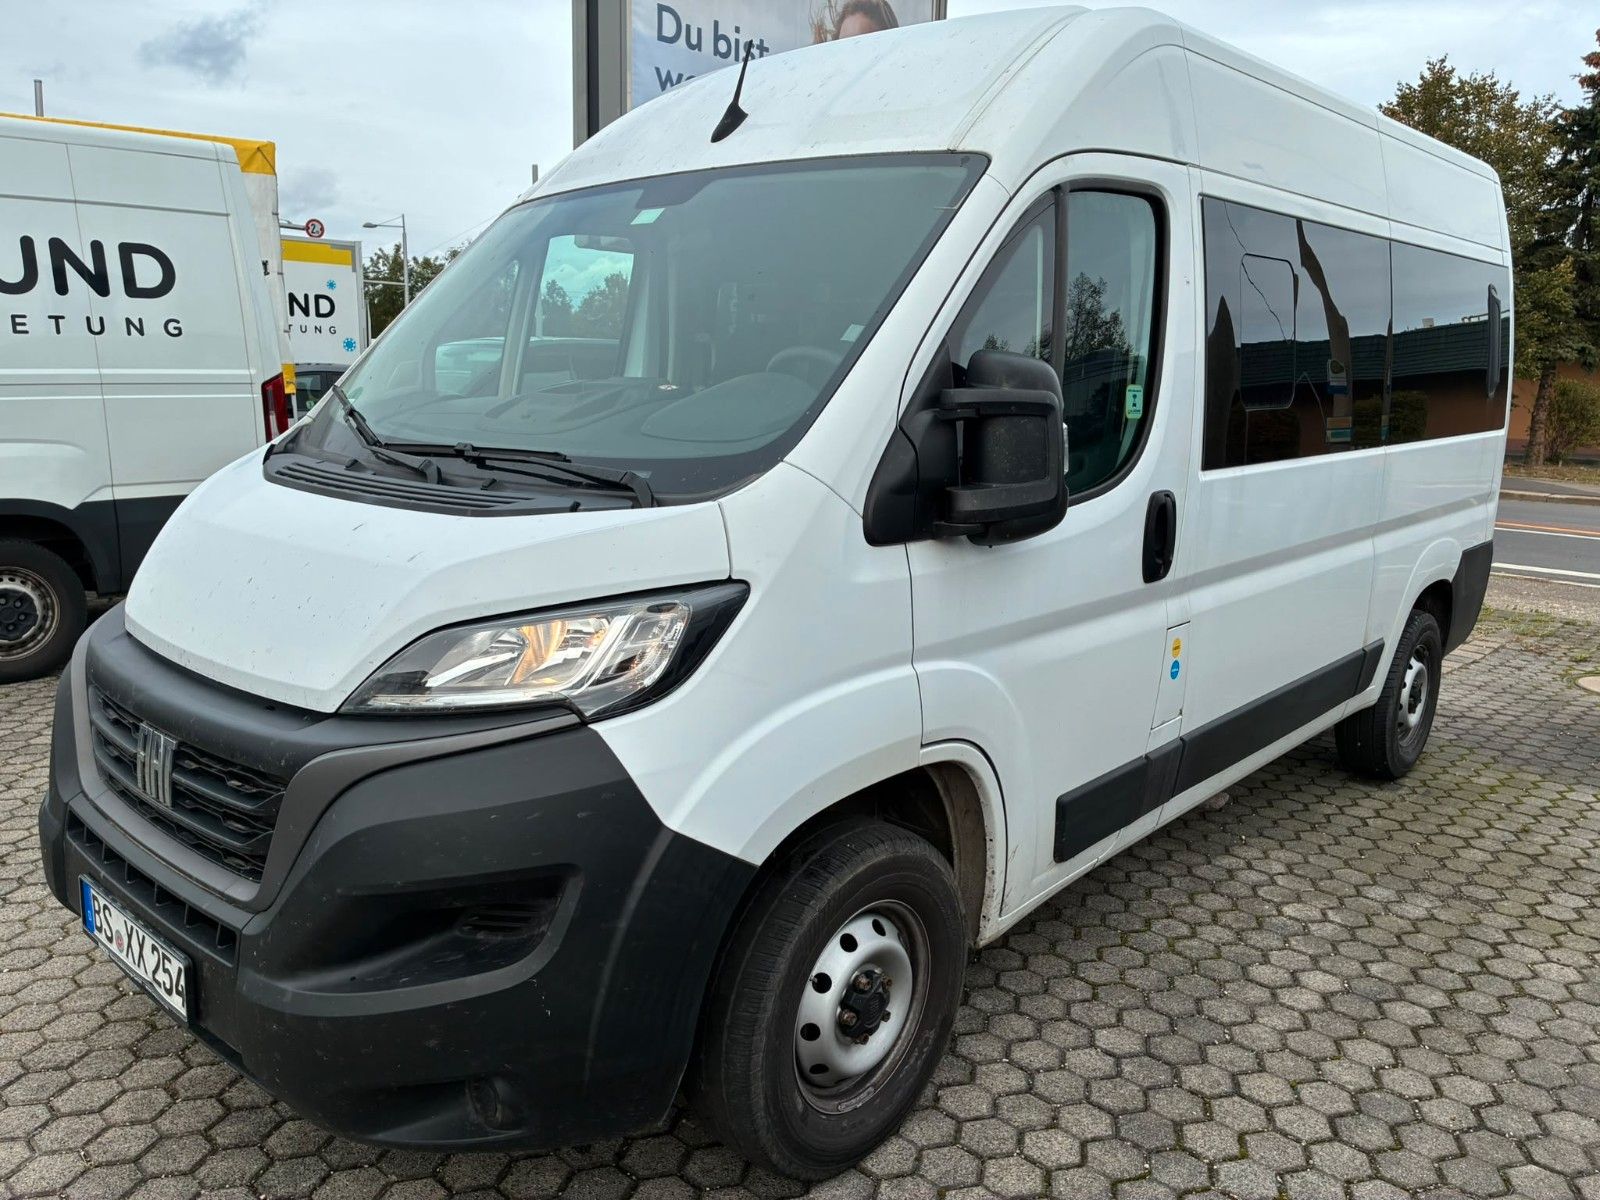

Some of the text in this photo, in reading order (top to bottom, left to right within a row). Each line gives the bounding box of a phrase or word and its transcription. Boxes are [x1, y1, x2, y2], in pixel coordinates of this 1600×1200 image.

[656, 2, 770, 62] Du bist
[10, 313, 183, 338] ETUNG
[288, 292, 336, 318] ND
[92, 893, 185, 1008] BS XX 254
